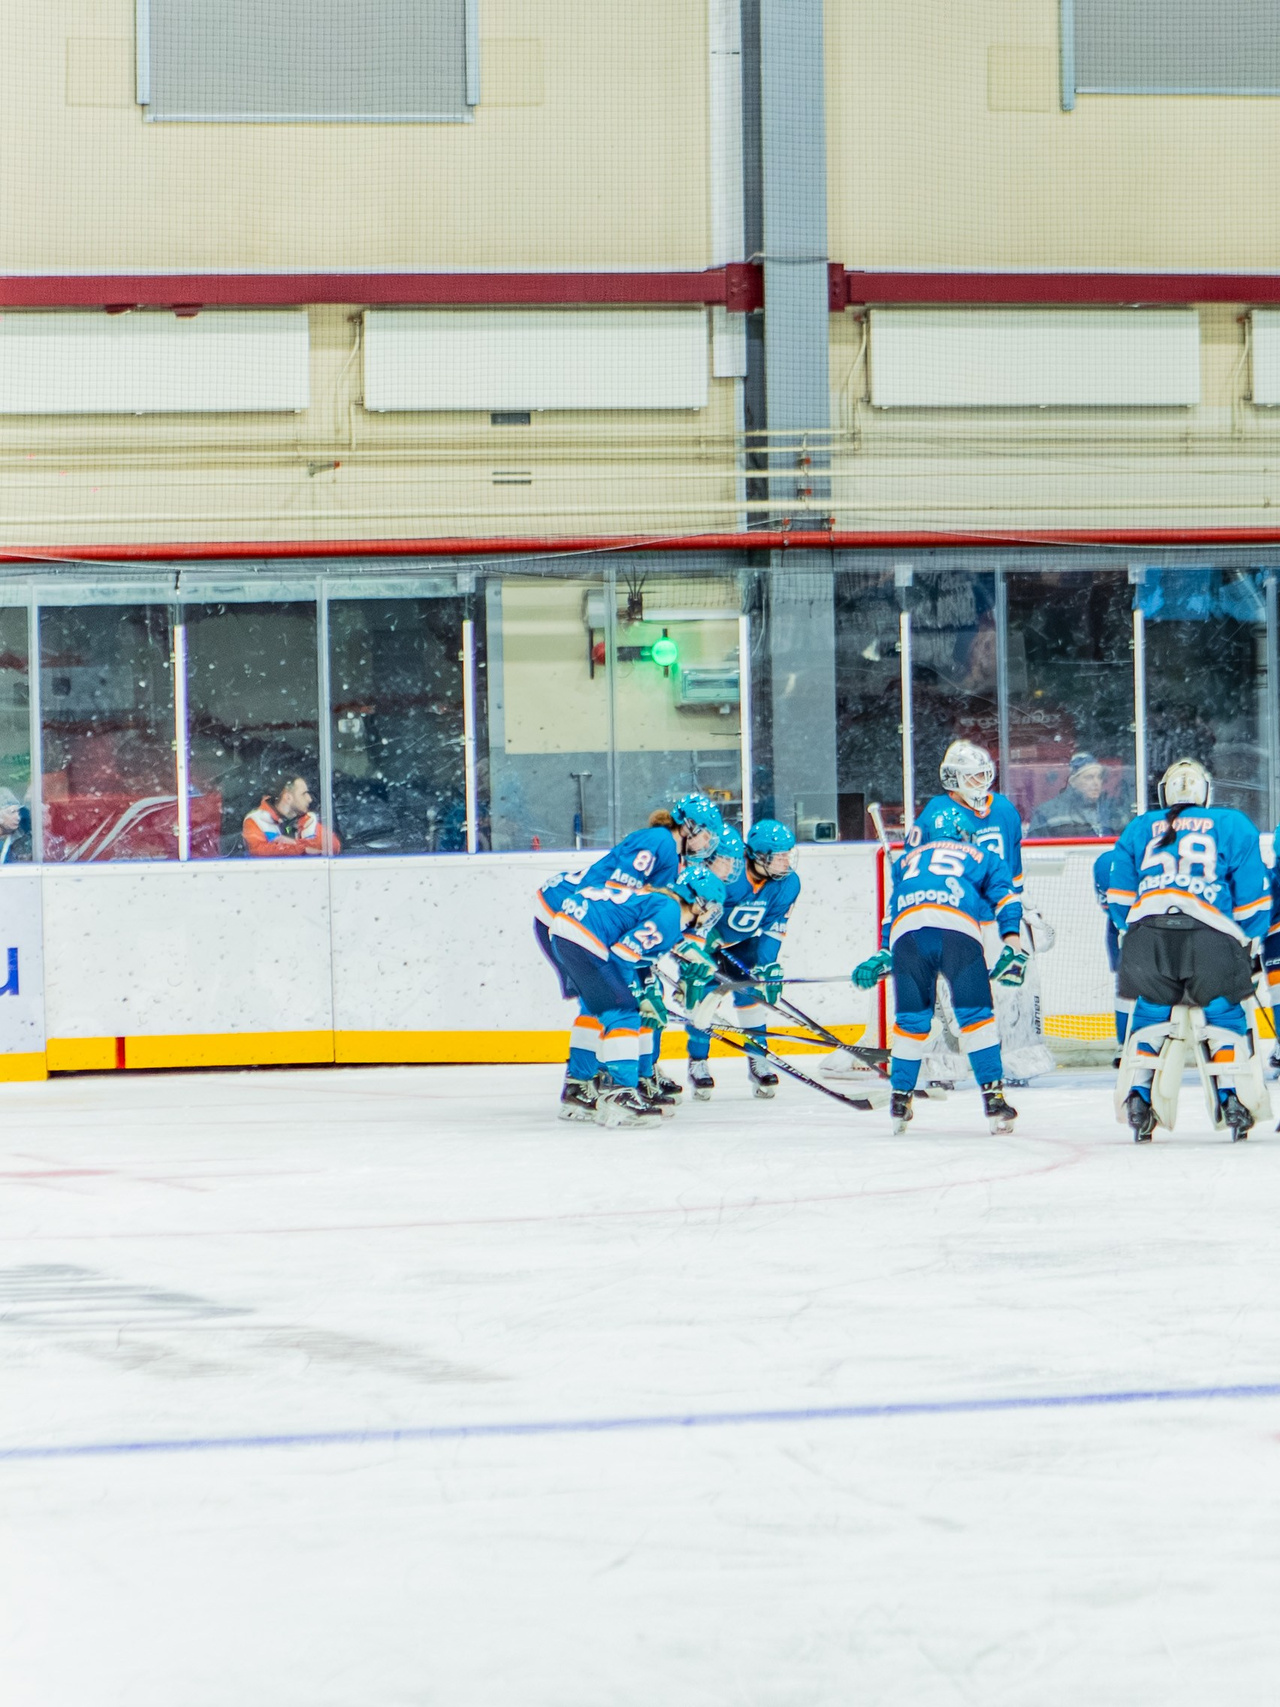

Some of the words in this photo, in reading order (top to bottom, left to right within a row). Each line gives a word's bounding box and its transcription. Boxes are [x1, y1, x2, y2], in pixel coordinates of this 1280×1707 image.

[1140, 832, 1217, 884] 58
[897, 876, 965, 912] Аврора
[633, 920, 663, 949] 23
[1033, 995, 1041, 1035] BAUER
